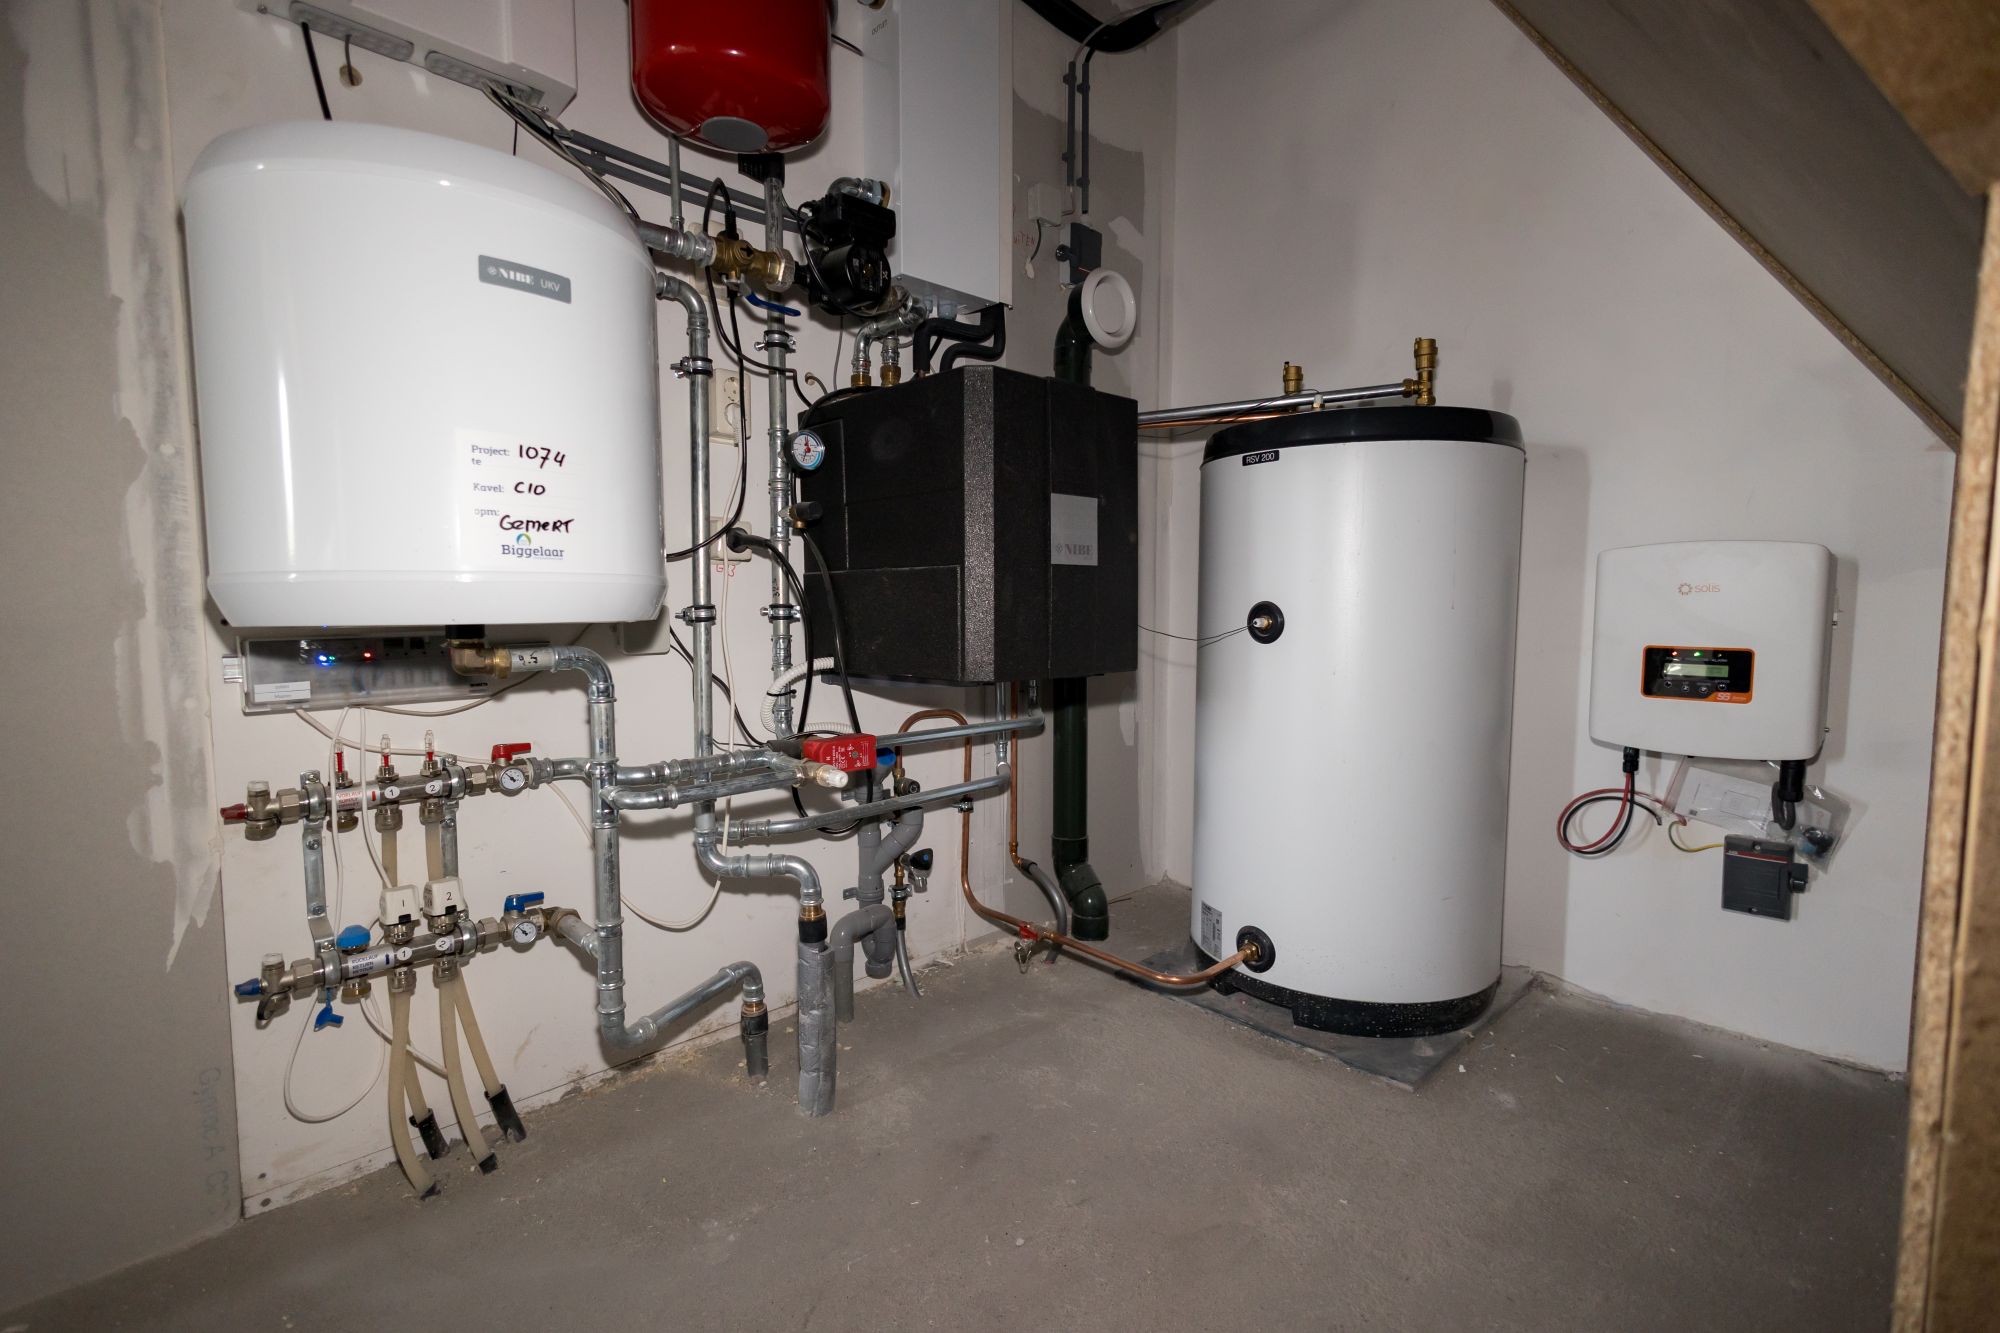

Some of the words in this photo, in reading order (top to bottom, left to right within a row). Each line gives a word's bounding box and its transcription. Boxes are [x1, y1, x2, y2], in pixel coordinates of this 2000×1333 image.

[498, 267, 535, 286] NIBE
[540, 279, 561, 292] UKV
[471, 444, 510, 457] Project:
[519, 444, 566, 469] 1074
[1246, 454, 1260, 465] RSV
[1261, 452, 1275, 462] 200
[473, 483, 505, 493] Kavel:
[501, 544, 565, 559] Biggelaar
[1064, 543, 1093, 556] NIBE
[1694, 583, 1721, 593] solis
[446, 891, 452, 901] 2
